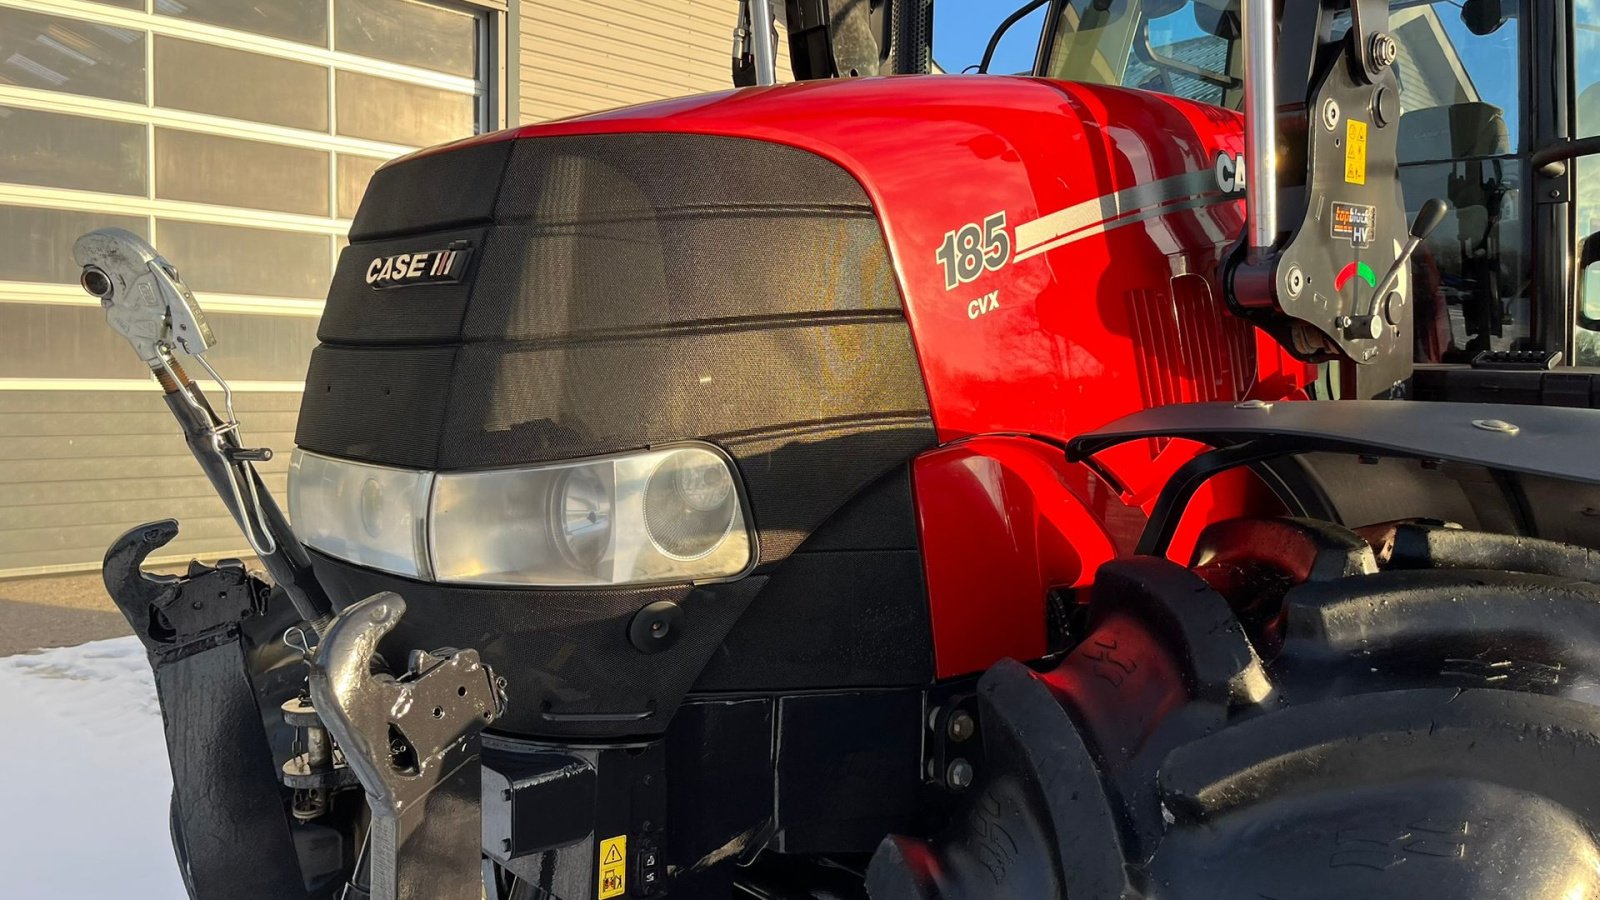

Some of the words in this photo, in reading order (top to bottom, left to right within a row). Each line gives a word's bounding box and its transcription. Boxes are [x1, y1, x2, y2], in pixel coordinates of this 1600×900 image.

[1353, 227, 1369, 242] HV
[936, 210, 1010, 291] 185
[366, 254, 428, 284] CASE
[968, 290, 1000, 319] CVX
